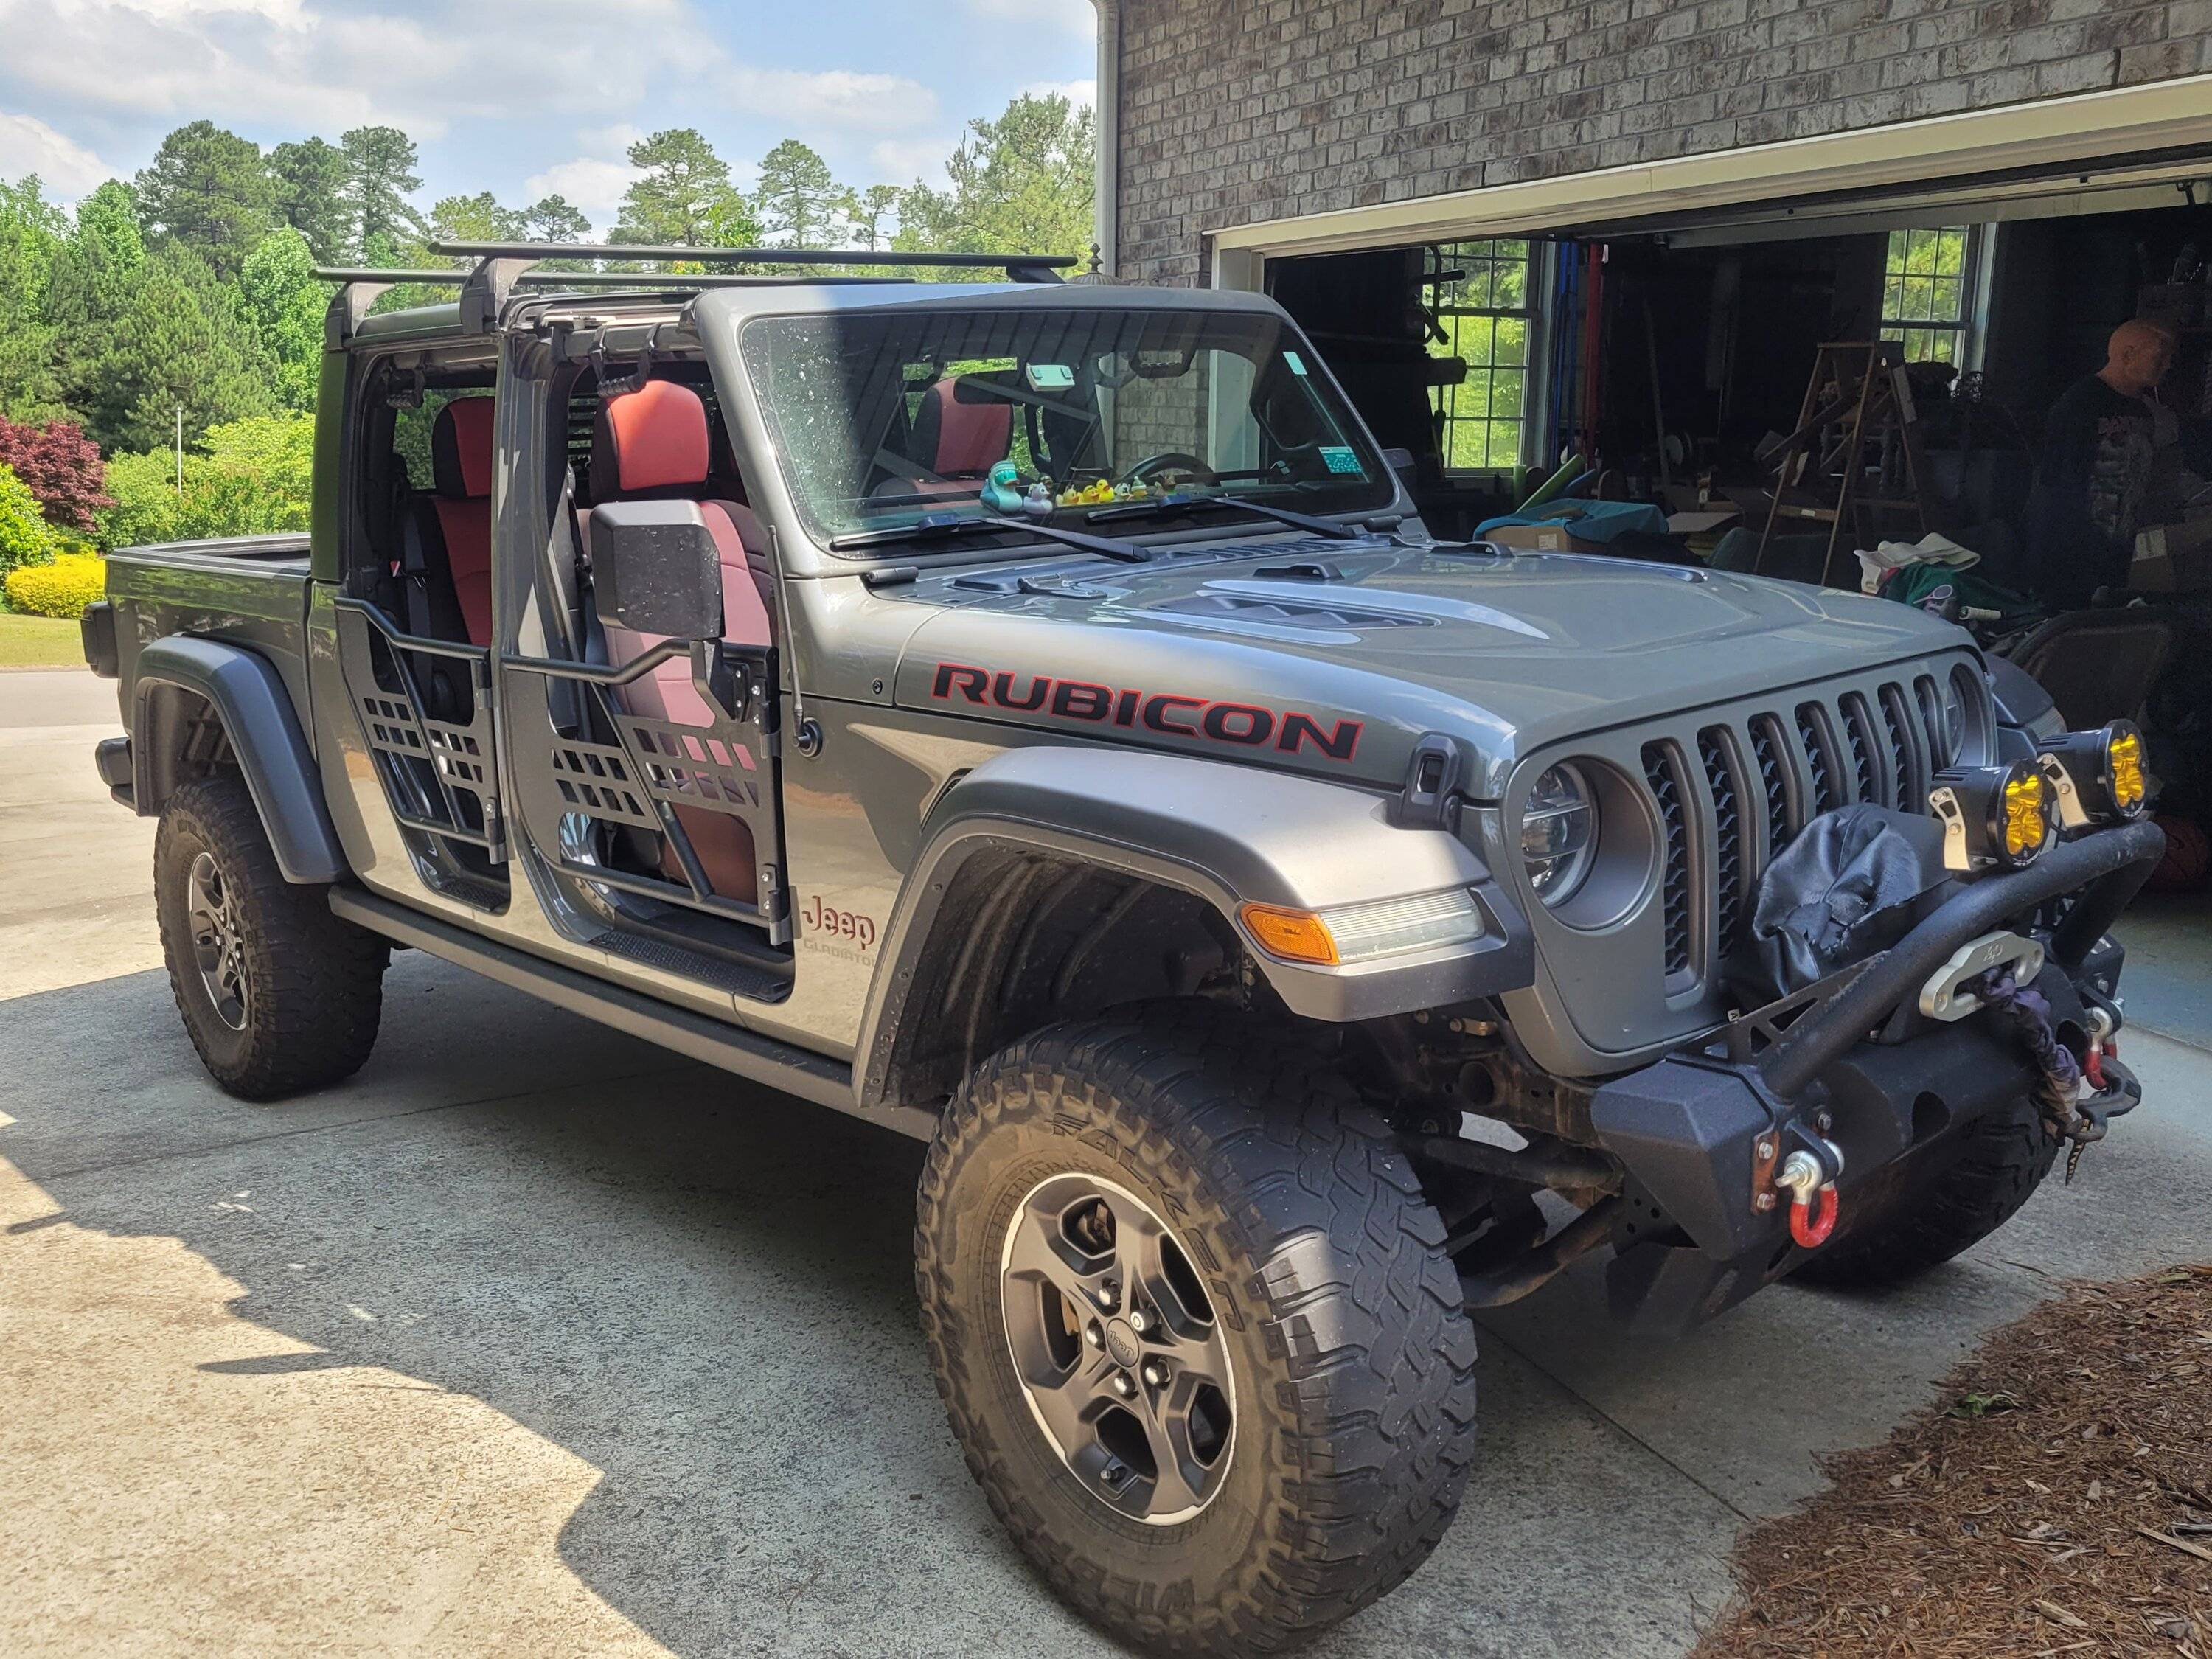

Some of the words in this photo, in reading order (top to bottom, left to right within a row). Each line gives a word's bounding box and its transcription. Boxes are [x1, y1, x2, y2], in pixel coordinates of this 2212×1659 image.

[931, 662, 1365, 763] RUBICON
[801, 895, 875, 950] Jeep
[804, 939, 874, 967] GLADIATO
[1051, 1112, 1245, 1332] FALKEN
